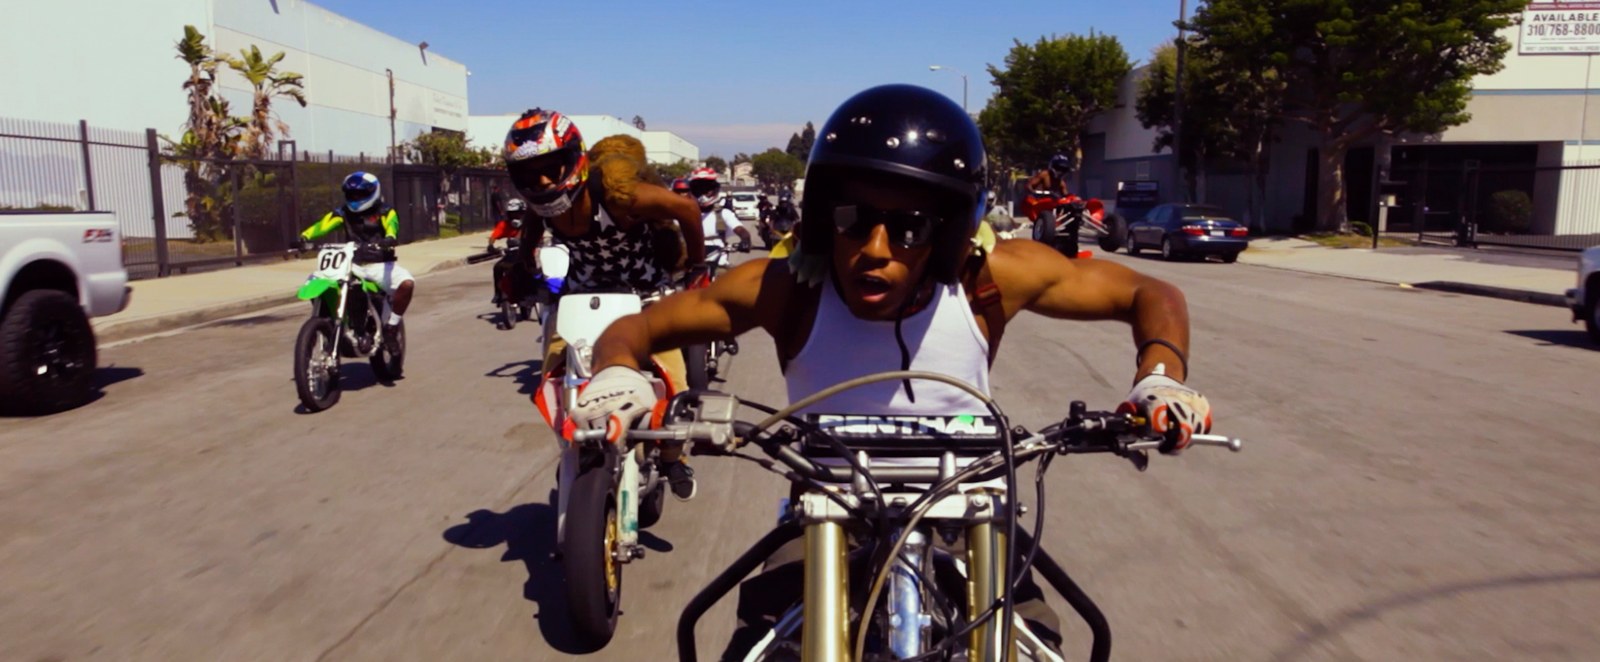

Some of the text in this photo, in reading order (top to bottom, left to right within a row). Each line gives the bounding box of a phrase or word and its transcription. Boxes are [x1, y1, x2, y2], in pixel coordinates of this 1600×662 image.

[1533, 13, 1599, 21] AVAILABLE
[320, 251, 346, 271] 60
[818, 414, 997, 435] RENTHAL
